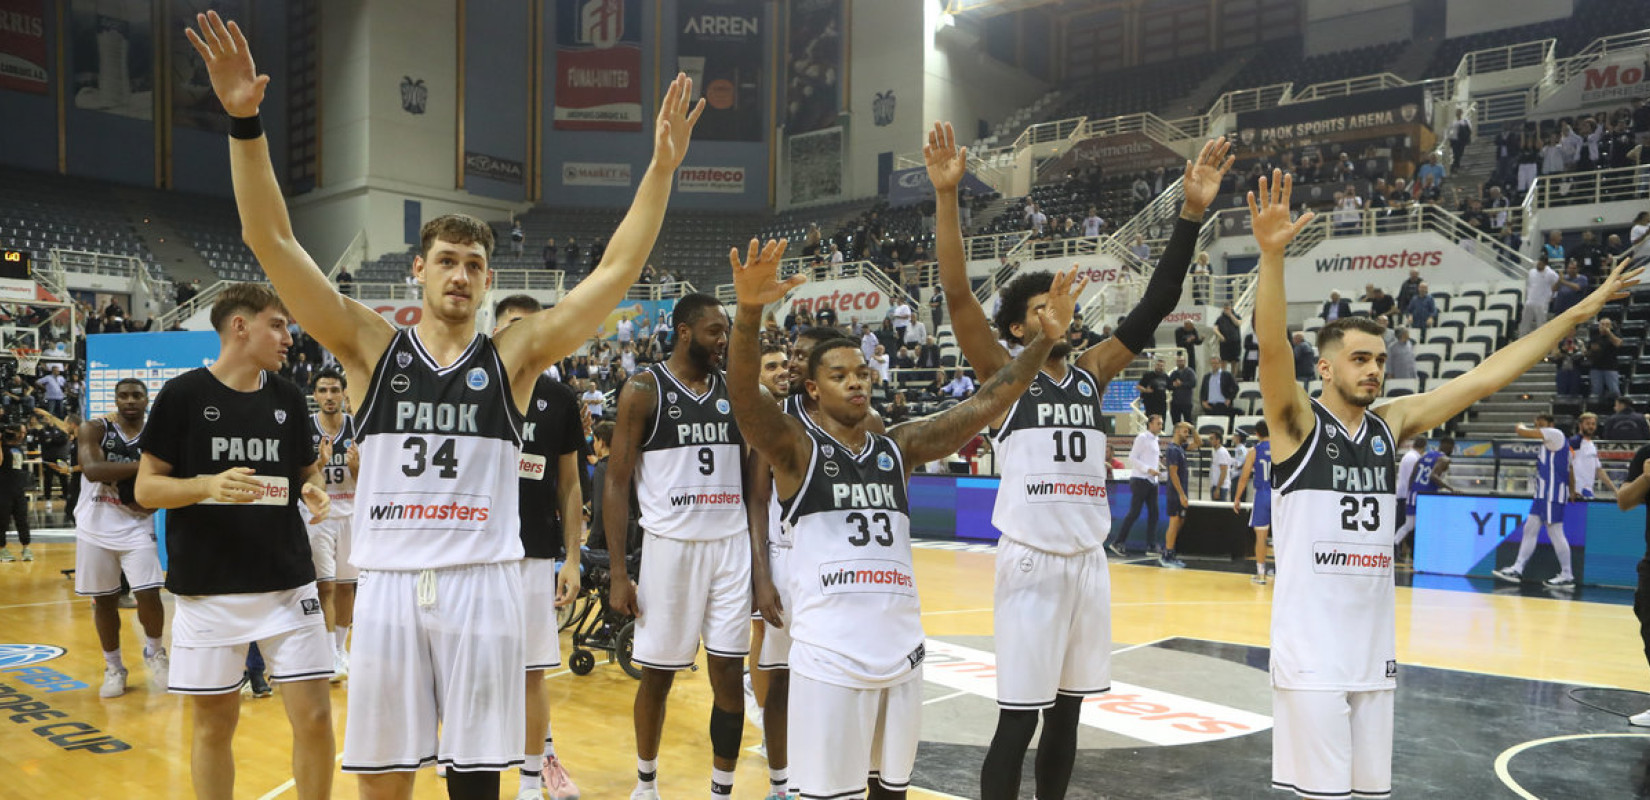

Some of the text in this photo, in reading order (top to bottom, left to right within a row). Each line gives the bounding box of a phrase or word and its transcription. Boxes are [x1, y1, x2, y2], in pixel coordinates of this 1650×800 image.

[1583, 65, 1643, 91] Mo
[1261, 110, 1394, 142] PAOK SPORTS ARENA
[680, 169, 744, 182] mateco
[1316, 248, 1443, 273] winmasters
[396, 400, 480, 433] PAOK
[1037, 403, 1096, 427] PAOK
[677, 421, 730, 445] PAOK
[211, 436, 281, 463] PAOK
[402, 436, 459, 479] 34
[1052, 430, 1087, 463] 10
[698, 447, 714, 476] 9
[324, 467, 345, 485] 19
[670, 491, 741, 506] winmasters
[832, 483, 898, 508] PAOK
[1026, 480, 1107, 498] winmasters
[369, 501, 490, 521] winmasters
[1339, 495, 1381, 532] 23
[845, 512, 894, 547] 33
[1314, 549, 1392, 569] winmaster
[820, 568, 914, 588] winmasters
[0, 666, 90, 693] FIBA
[32, 721, 133, 755] CUP
